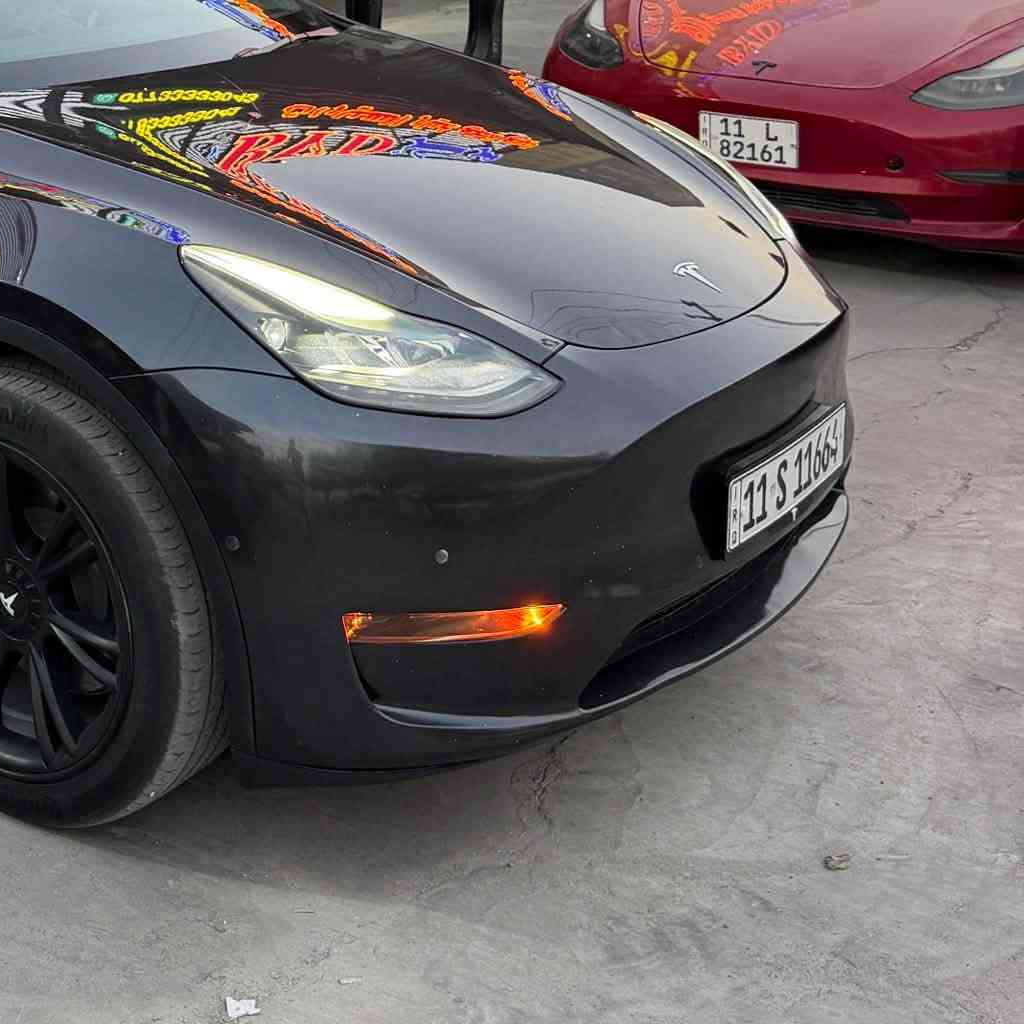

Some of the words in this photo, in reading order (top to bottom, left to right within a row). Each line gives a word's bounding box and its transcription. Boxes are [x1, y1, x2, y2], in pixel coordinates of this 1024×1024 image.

[720, 118, 745, 138] 11
[765, 122, 778, 141] L
[719, 139, 786, 164] 82161
[743, 473, 767, 532] 11
[776, 459, 788, 510] S
